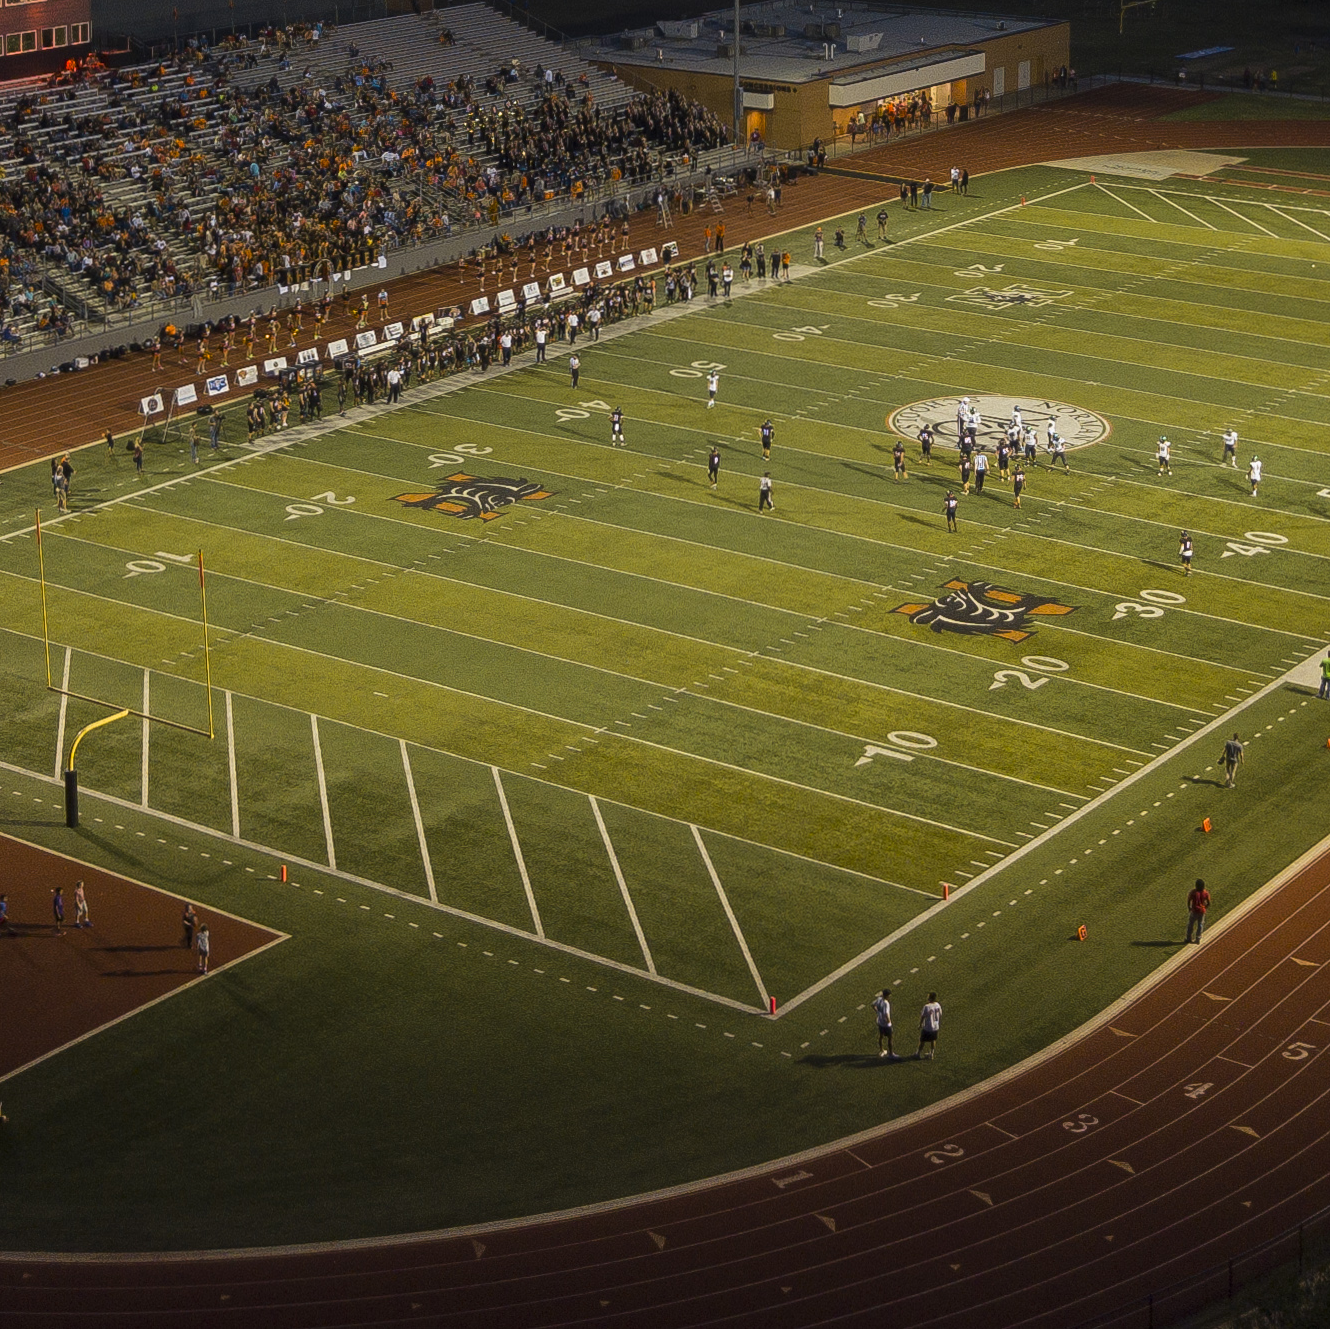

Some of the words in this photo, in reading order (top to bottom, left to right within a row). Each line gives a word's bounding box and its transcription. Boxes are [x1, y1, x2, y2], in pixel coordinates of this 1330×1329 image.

[1033, 237, 1080, 251] 10
[953, 263, 1004, 279] 20
[868, 291, 922, 310] 30
[773, 323, 831, 343] 40
[669, 360, 728, 380] 50
[554, 399, 613, 422] 40
[427, 443, 494, 469] 30
[284, 489, 357, 521] 20
[1220, 530, 1289, 560] 40
[126, 550, 194, 579] 10
[1112, 588, 1187, 621] 30
[989, 655, 1070, 692] 20
[854, 729, 939, 769] 10
[923, 1142, 966, 1165] 2
[1061, 1112, 1100, 1134] 3
[1182, 1081, 1216, 1101] 4
[1281, 1041, 1318, 1062] 5
